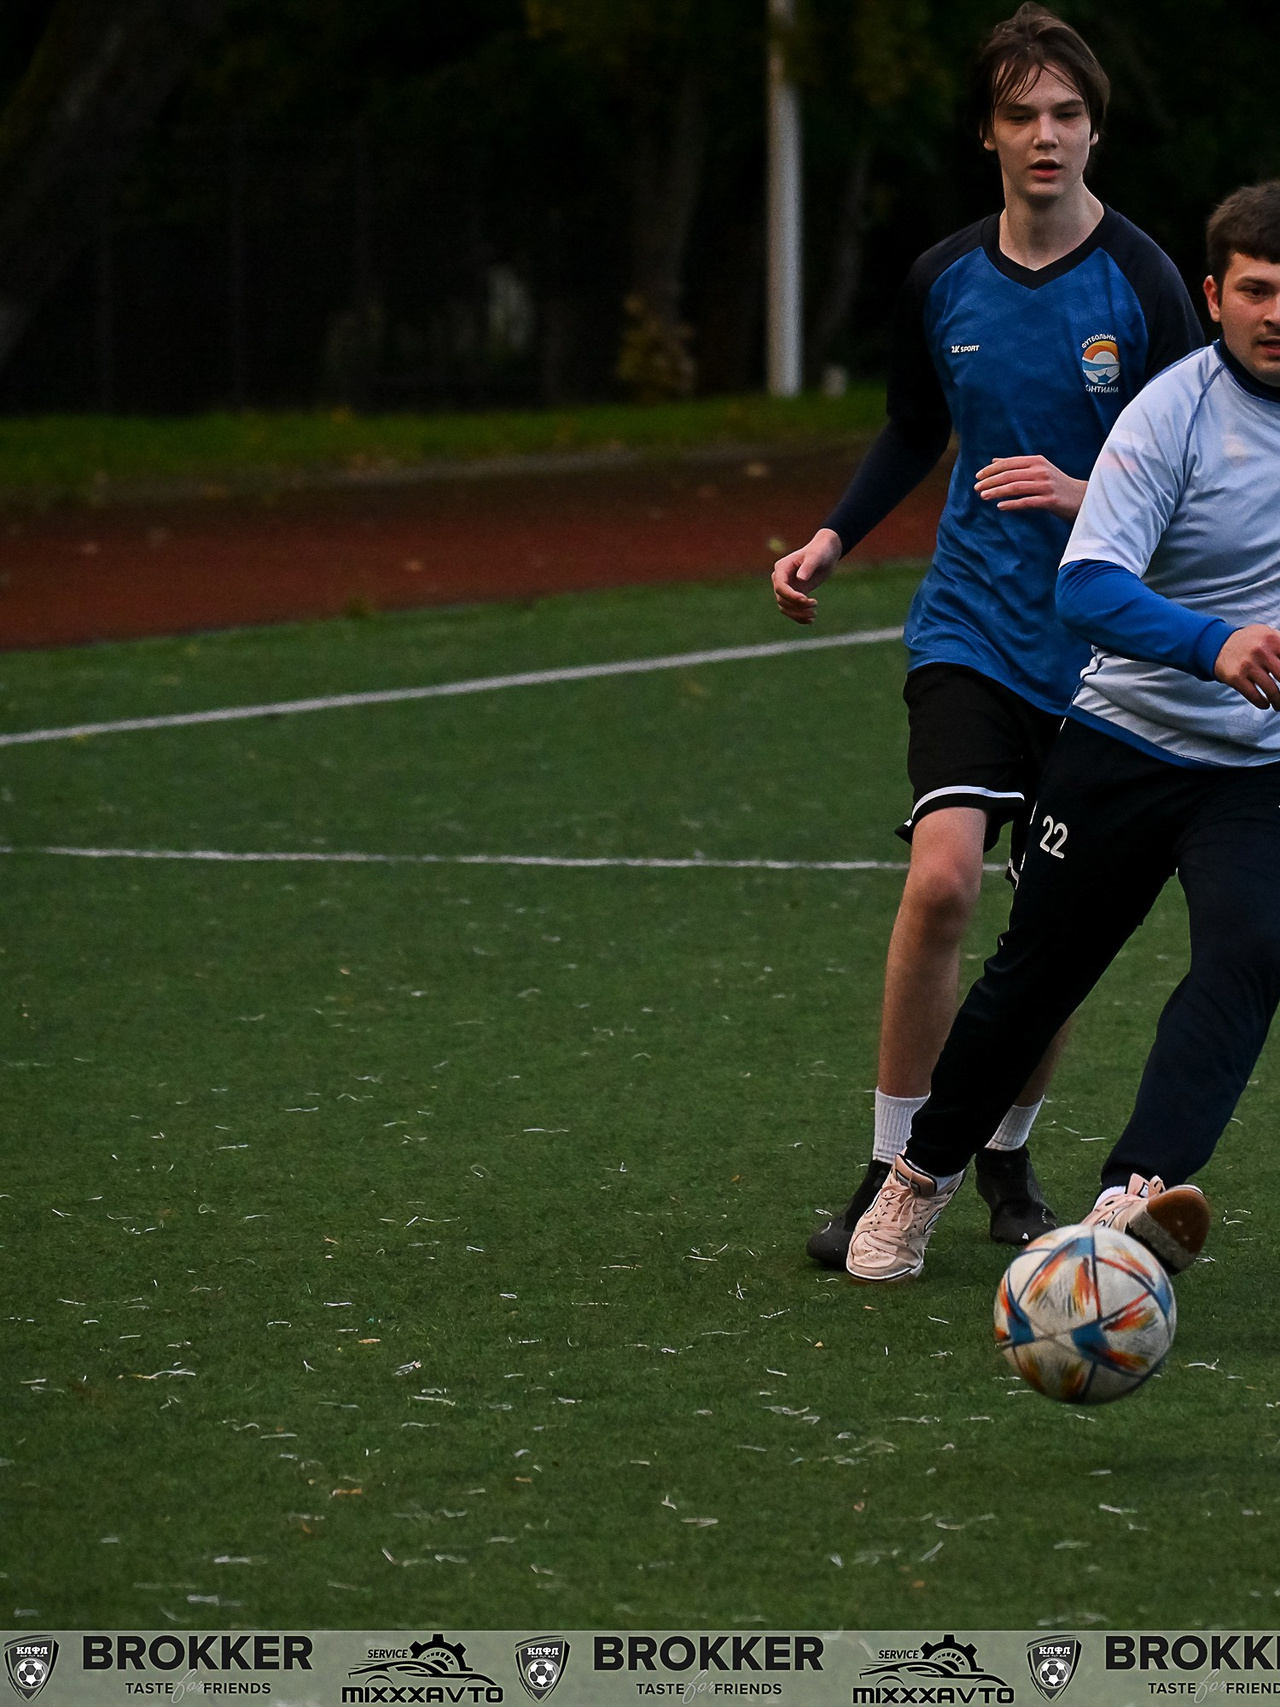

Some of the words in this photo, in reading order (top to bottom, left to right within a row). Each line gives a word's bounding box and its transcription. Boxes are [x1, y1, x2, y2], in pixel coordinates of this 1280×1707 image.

[960, 345, 980, 353] SPORT
[1081, 333, 1117, 349] ФУТБОЛЬНЫ
[1039, 815, 1068, 859] 22
